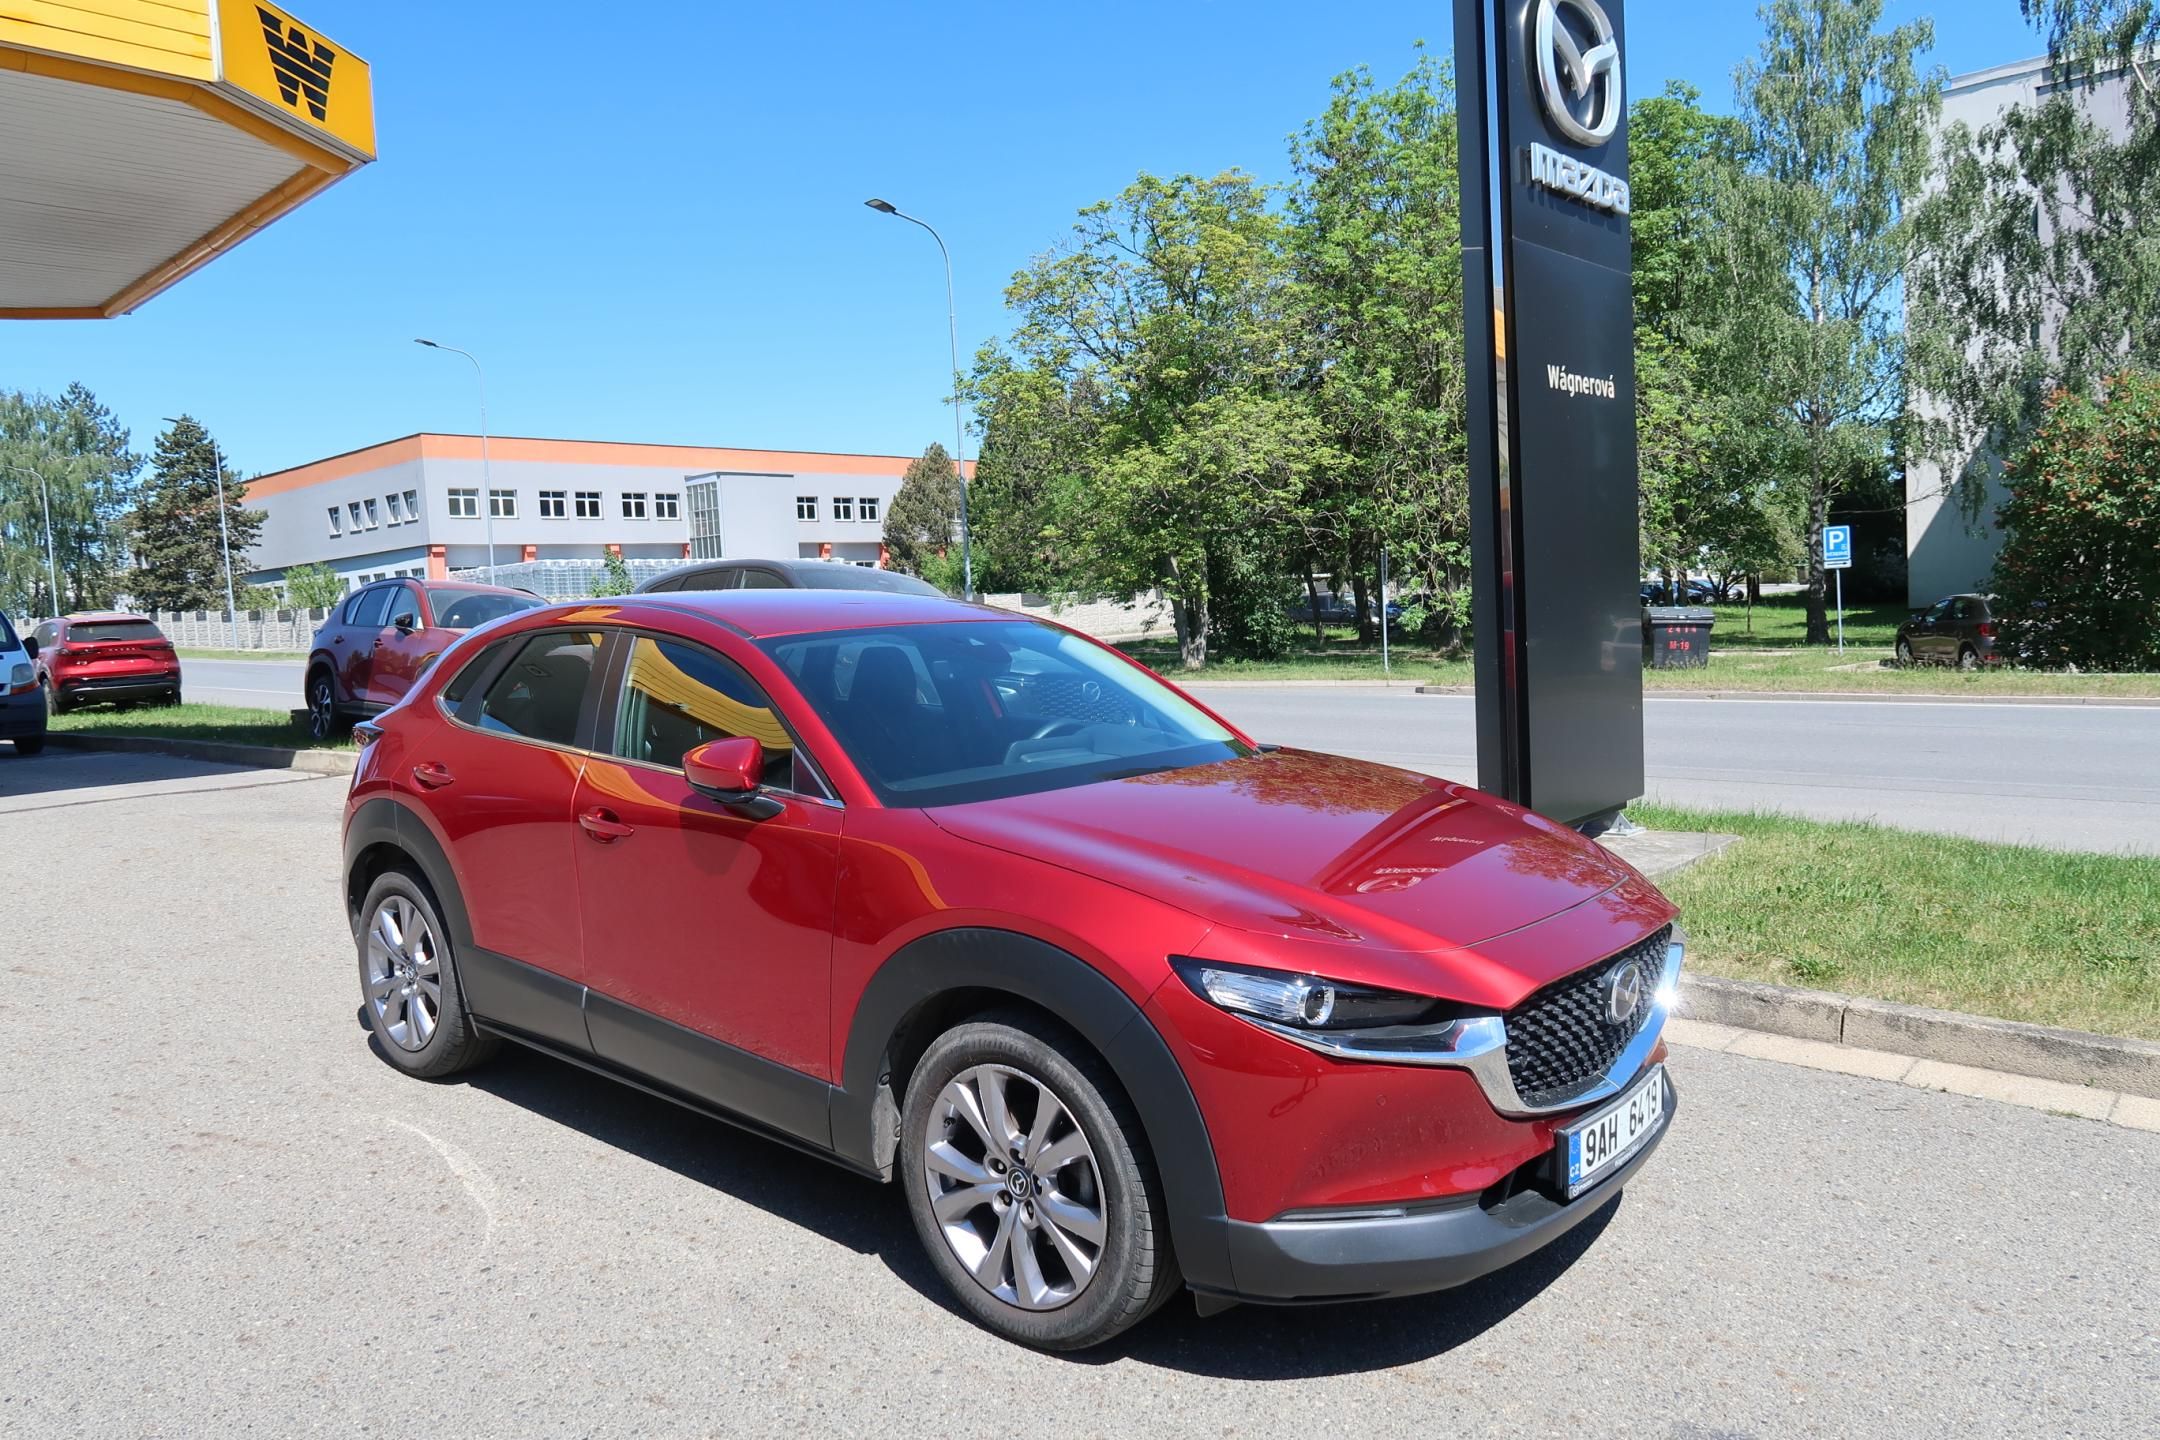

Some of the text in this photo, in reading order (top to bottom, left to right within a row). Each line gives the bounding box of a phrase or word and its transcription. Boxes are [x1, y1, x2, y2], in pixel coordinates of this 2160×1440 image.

[255, 5, 336, 123] W
[1530, 141, 1629, 214] mazda
[1547, 364, 1615, 398] Wágnerová
[1829, 531, 1844, 550] P
[1585, 1113, 1618, 1167] 9AH
[1629, 1079, 1657, 1137] 6419
[1569, 1163, 1580, 1178] CZ
